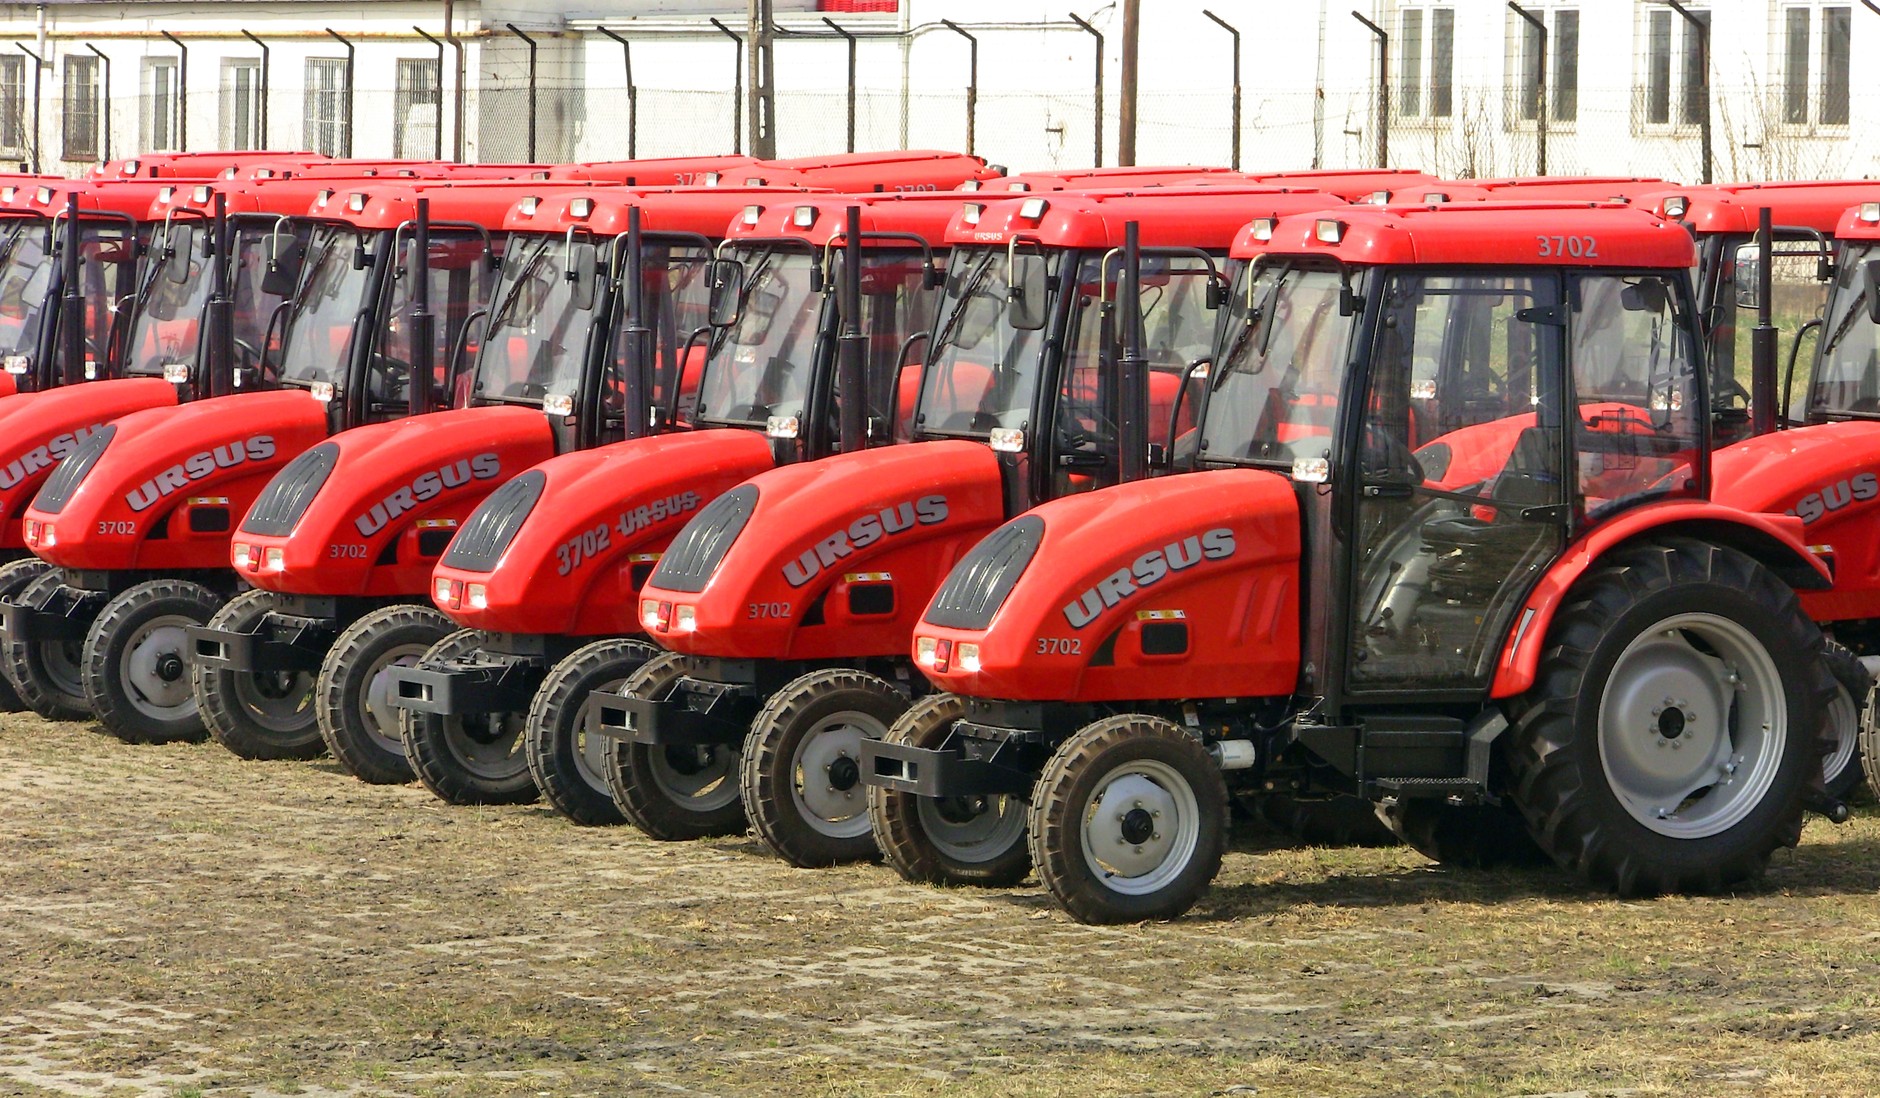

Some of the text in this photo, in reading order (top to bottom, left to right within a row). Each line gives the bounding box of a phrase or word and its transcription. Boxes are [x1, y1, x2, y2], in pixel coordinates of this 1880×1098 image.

[974, 231, 1003, 241] URSUS
[1536, 234, 1599, 258] 3702
[125, 434, 277, 512] URSUS
[355, 452, 501, 537] URSUS
[1784, 472, 1879, 526] SUS
[98, 520, 136, 535] 3702
[782, 494, 950, 588] URSUS
[330, 543, 368, 559] 3702
[556, 523, 611, 577] 3702
[1063, 527, 1237, 629] URSUS
[748, 601, 792, 619] 3702
[1036, 637, 1082, 655] 3702
